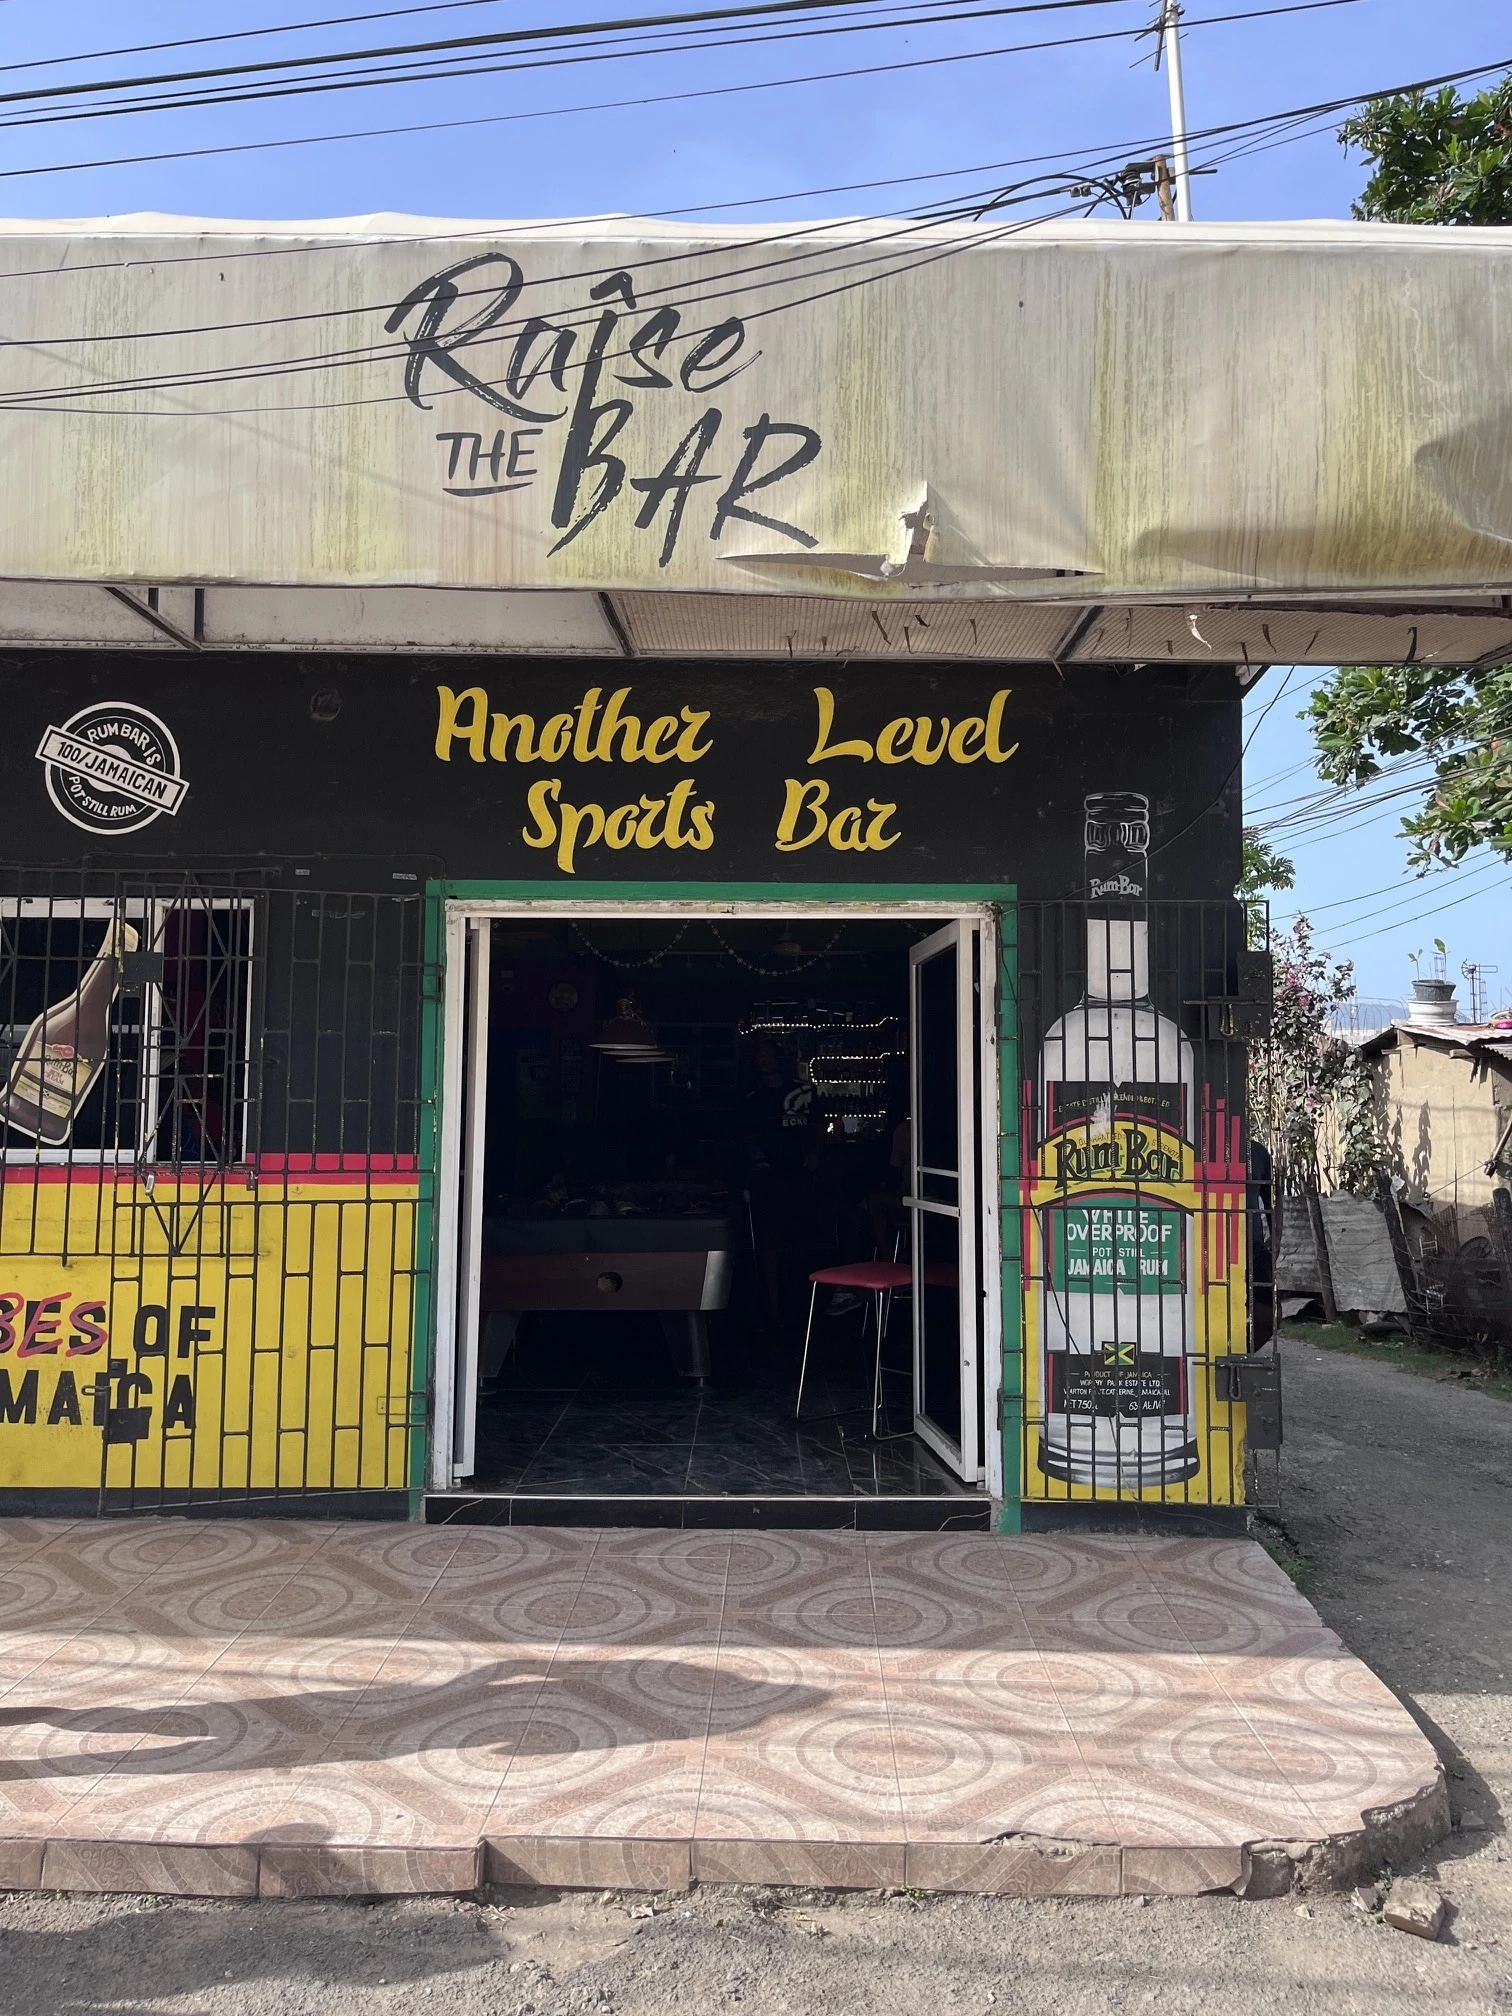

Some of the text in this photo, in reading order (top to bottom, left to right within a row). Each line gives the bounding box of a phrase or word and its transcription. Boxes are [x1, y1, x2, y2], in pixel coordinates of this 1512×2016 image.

[436, 400, 822, 567] THE BAR
[87, 722, 161, 766] RUM BAR IS
[434, 685, 1020, 766] Another Level
[69, 776, 137, 818] POT STILL RUM
[522, 779, 902, 874] Sports Bar
[1066, 1223, 1173, 1242] OVERPROOF
[1092, 1247, 1111, 1257] POT
[133, 1304, 216, 1359] OF
